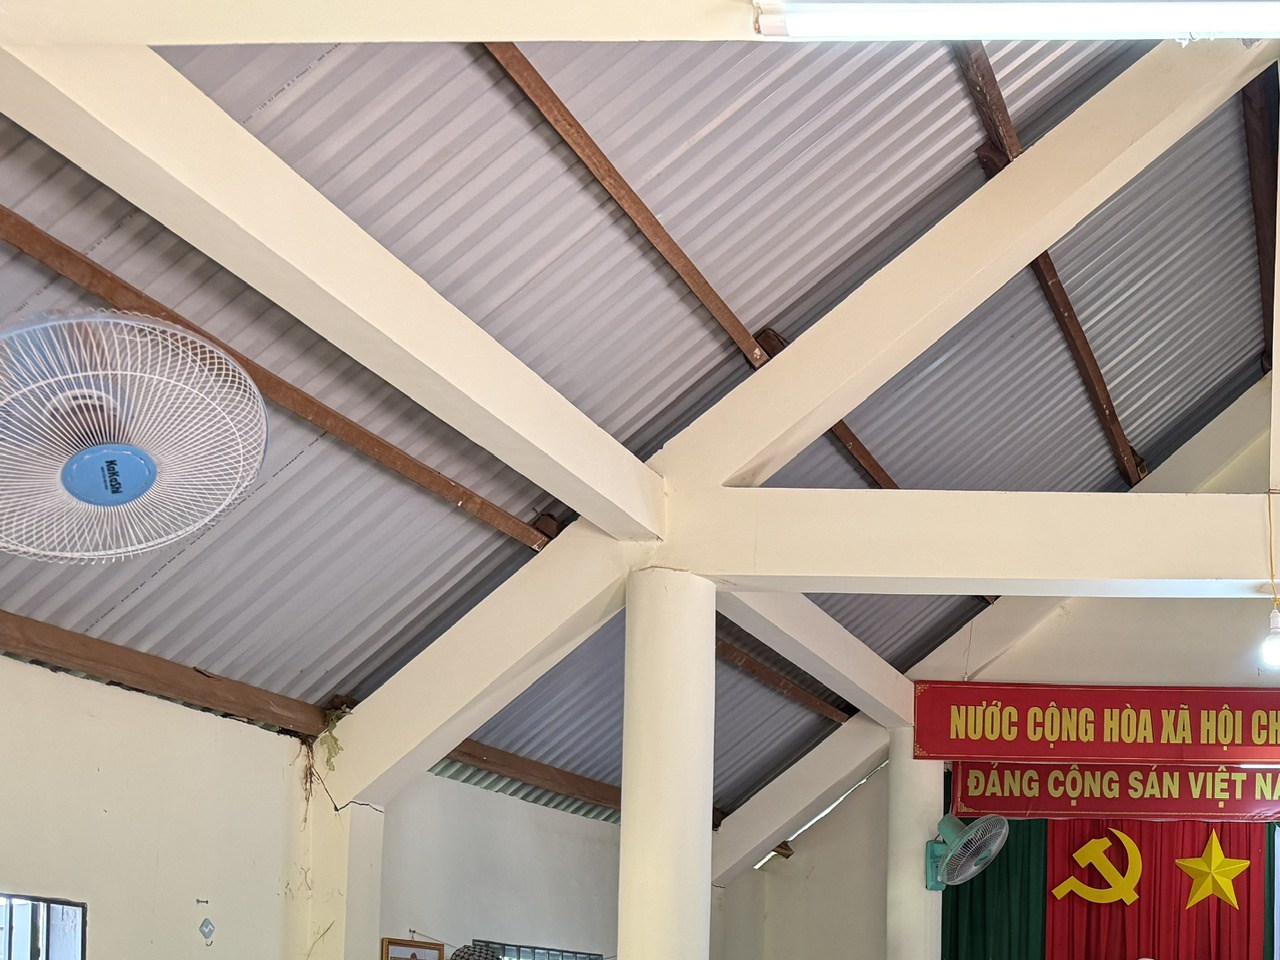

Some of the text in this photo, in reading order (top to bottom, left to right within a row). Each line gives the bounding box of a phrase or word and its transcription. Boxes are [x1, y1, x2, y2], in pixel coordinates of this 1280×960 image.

[950, 700, 1018, 741] NƯỚC
[1027, 702, 1095, 748] CỘNG
[1103, 703, 1154, 743] HÒA
[1160, 704, 1192, 744] XÃ
[1201, 704, 1242, 750] HỘI
[967, 762, 1040, 798] ĐẢNG
[1046, 764, 1119, 806] CỘNG
[1127, 764, 1180, 799] SẢN
[1188, 765, 1247, 808] VIỆT
